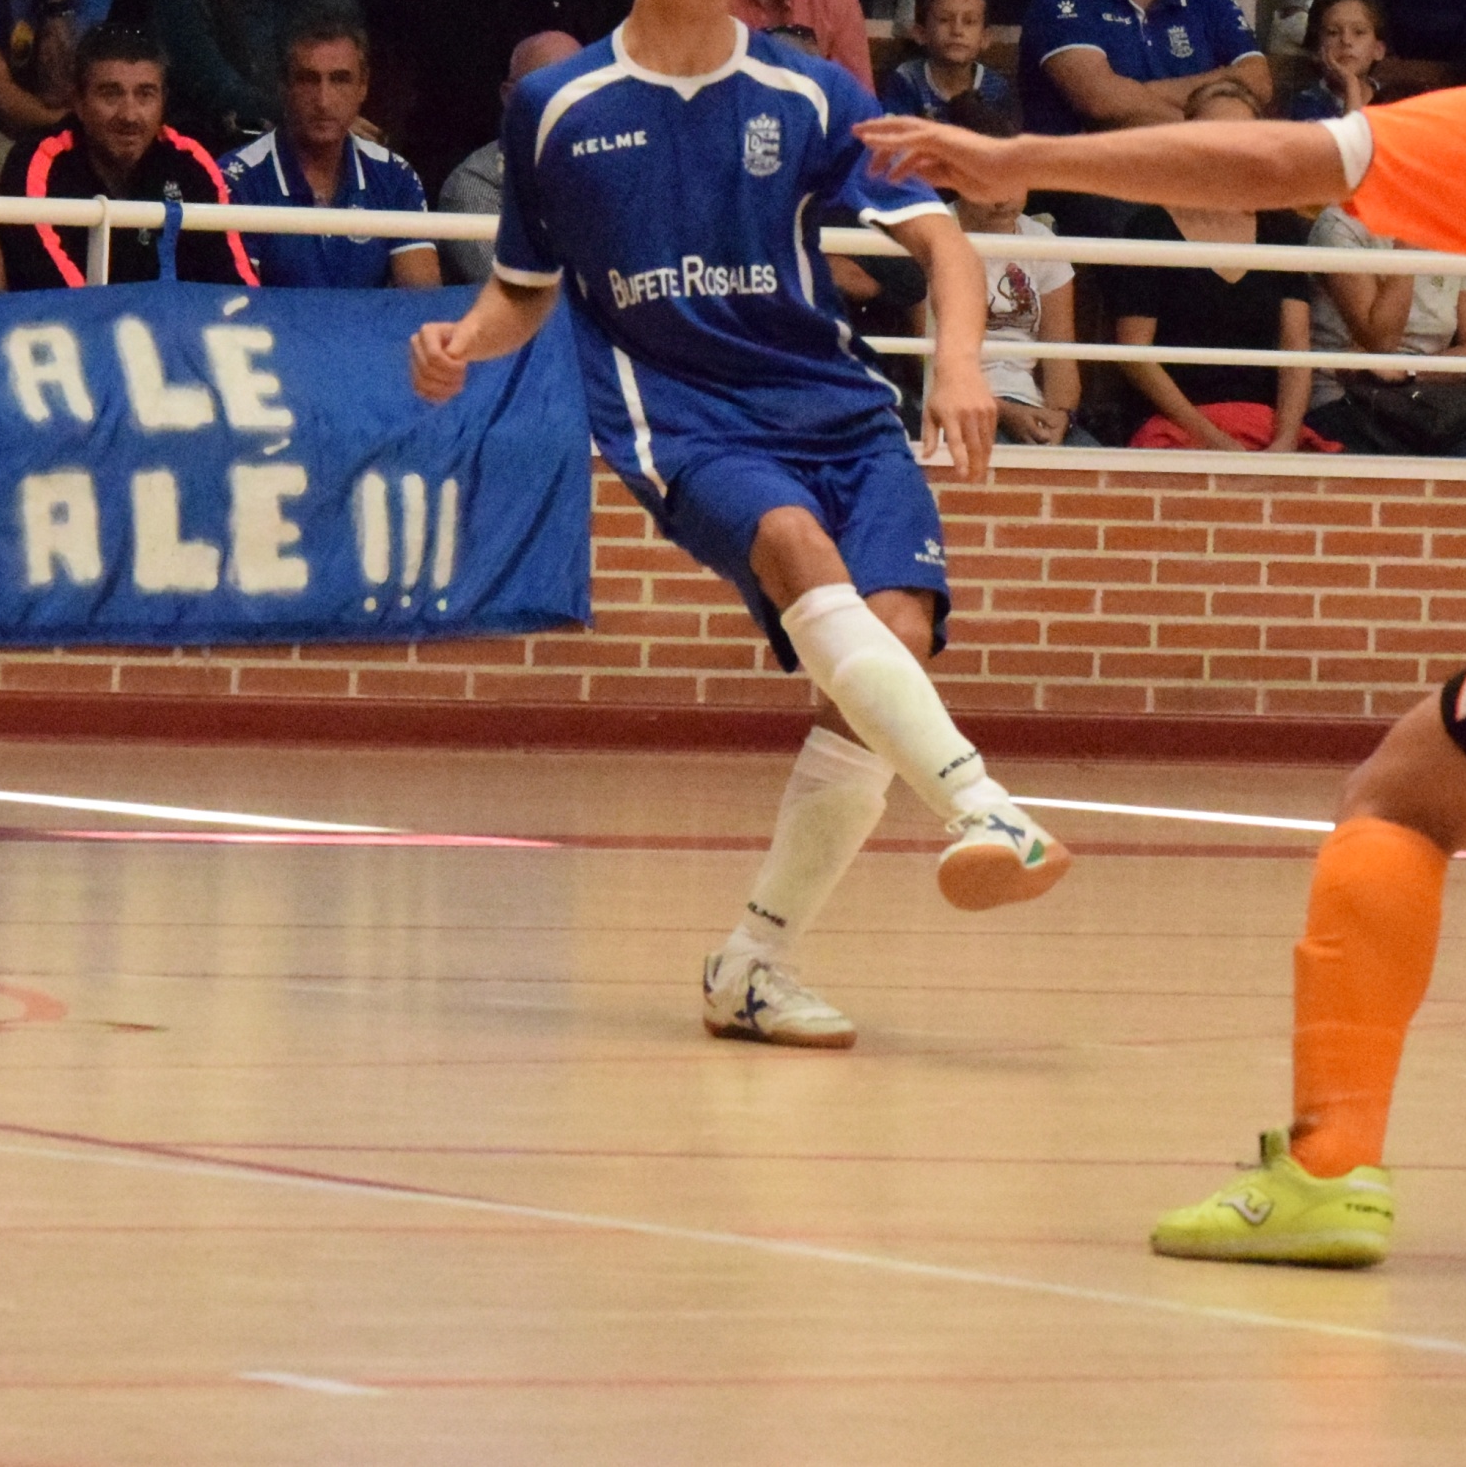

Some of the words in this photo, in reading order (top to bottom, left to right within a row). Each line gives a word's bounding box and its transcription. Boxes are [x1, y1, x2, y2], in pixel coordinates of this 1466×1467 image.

[572, 130, 648, 158] KELME
[608, 268, 681, 309] BUFETE
[682, 255, 778, 297] ROSALES
[3, 295, 293, 433] ALÉ
